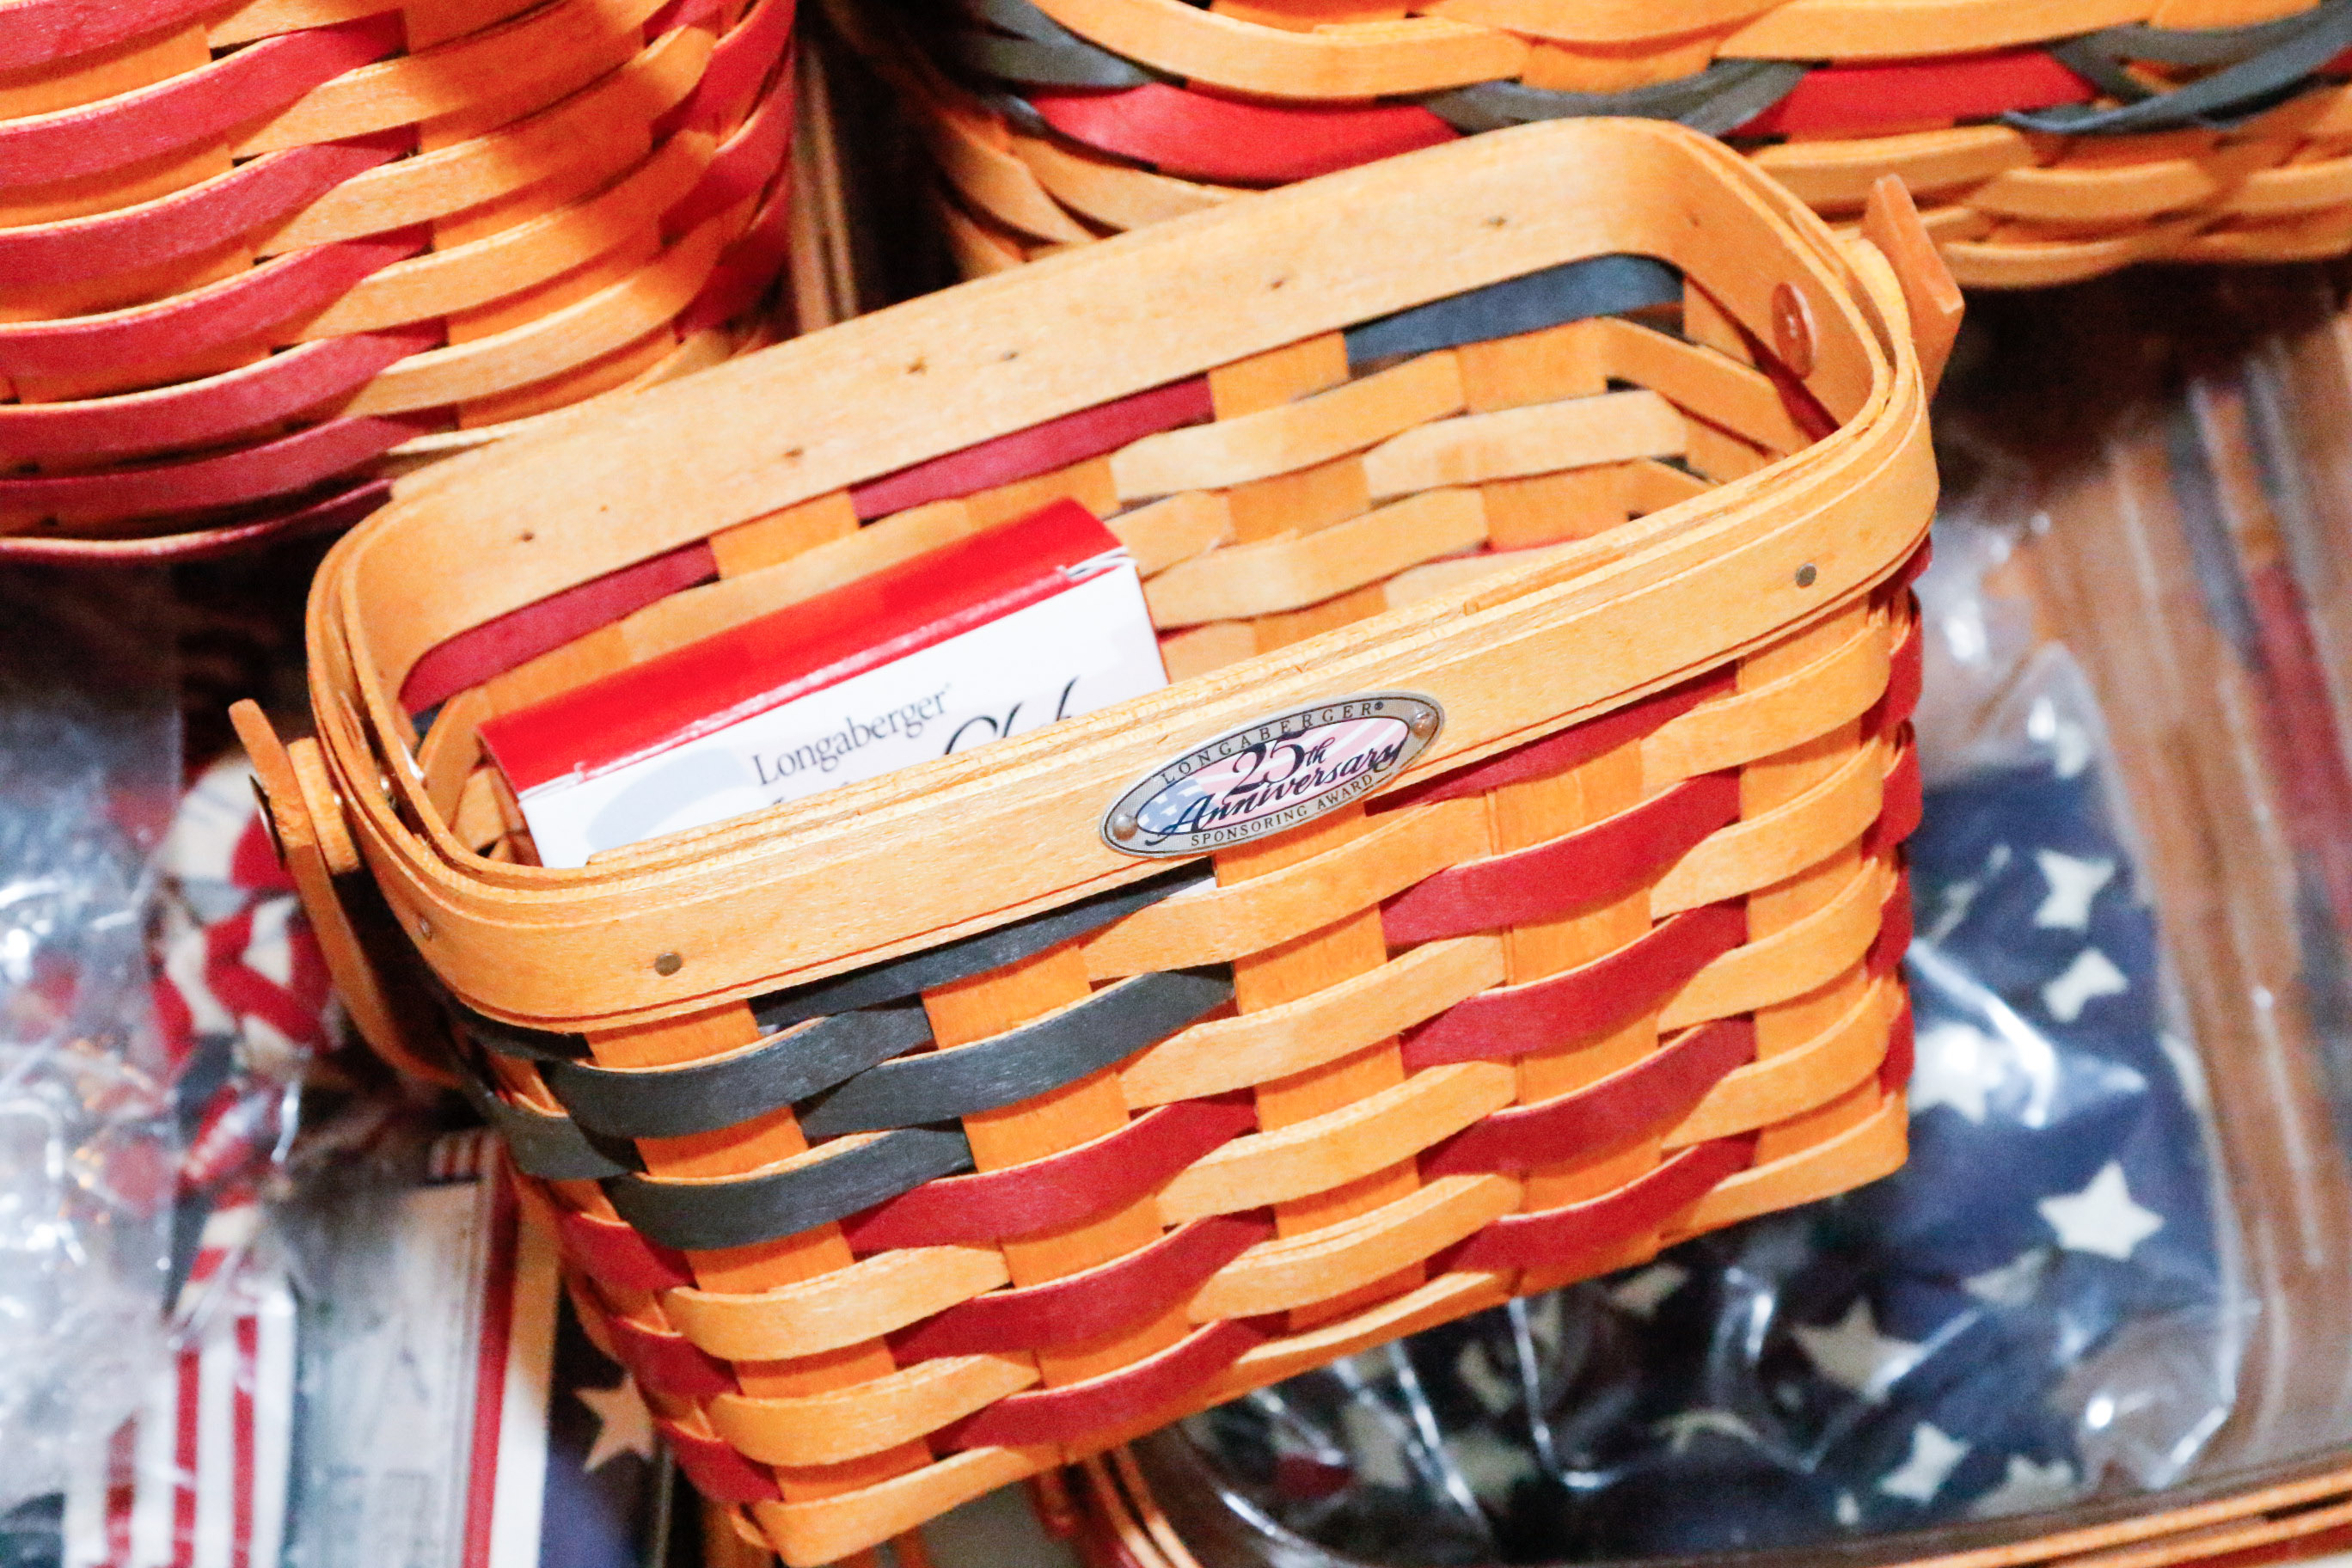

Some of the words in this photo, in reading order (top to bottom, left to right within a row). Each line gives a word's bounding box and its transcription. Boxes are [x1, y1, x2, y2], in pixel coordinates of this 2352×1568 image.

[752, 690, 946, 787] Longaberger
[1144, 737, 1407, 847] Anniversary
[1191, 804, 1308, 848] SPONSORING
[1315, 775, 1374, 812] AWARD
